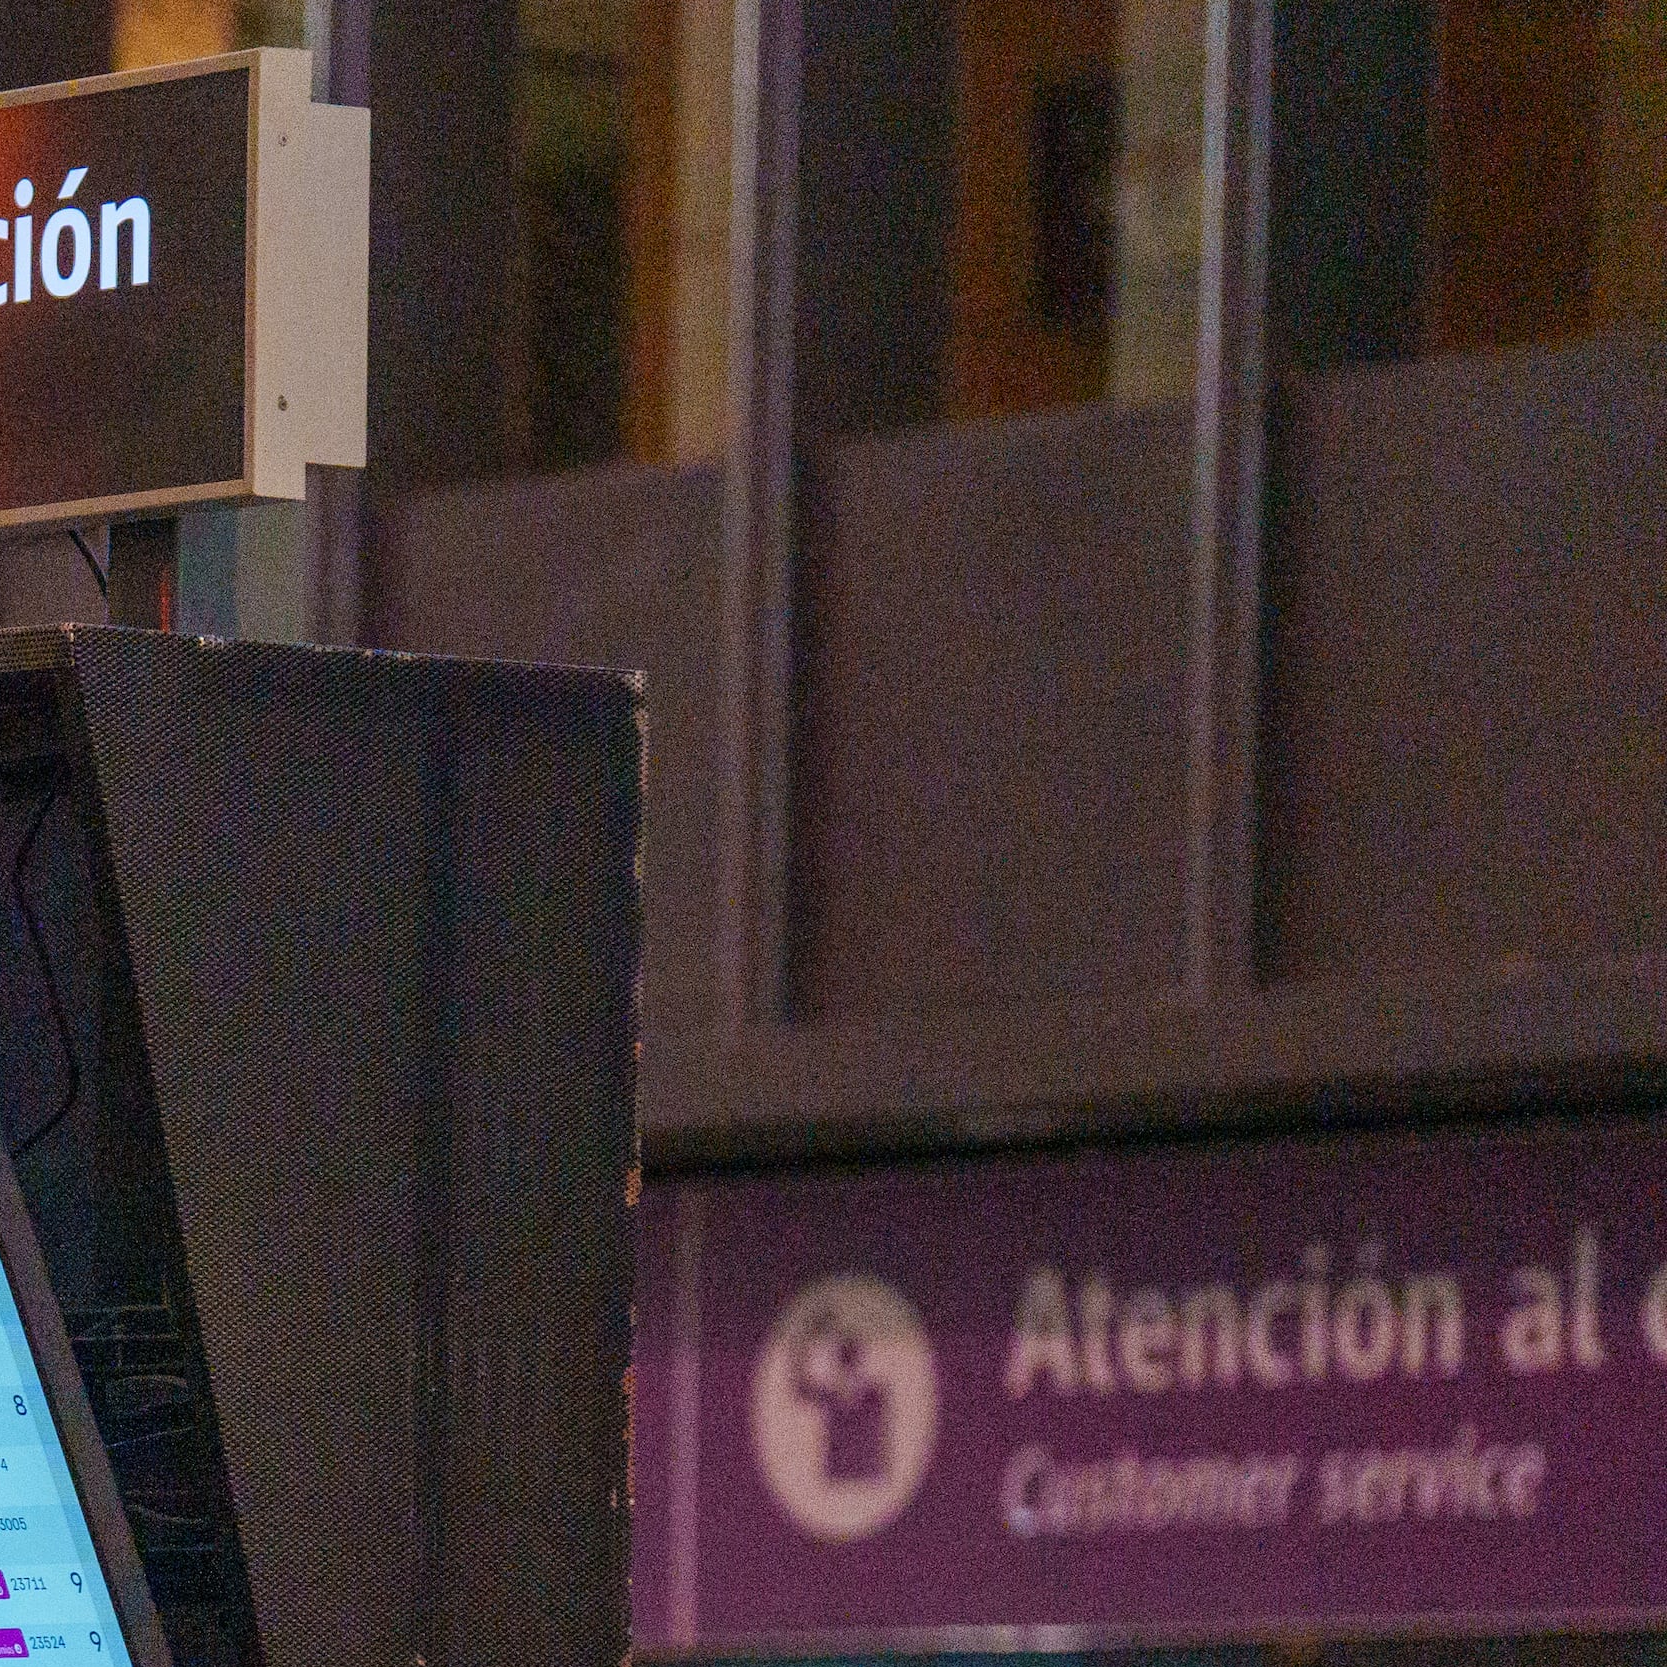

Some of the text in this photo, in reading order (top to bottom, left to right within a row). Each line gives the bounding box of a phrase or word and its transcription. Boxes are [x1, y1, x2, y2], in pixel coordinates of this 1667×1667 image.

[1006, 1240, 1466, 1397] Atención
[1501, 1228, 1605, 1374] al
[13, 1394, 28, 1416] 8
